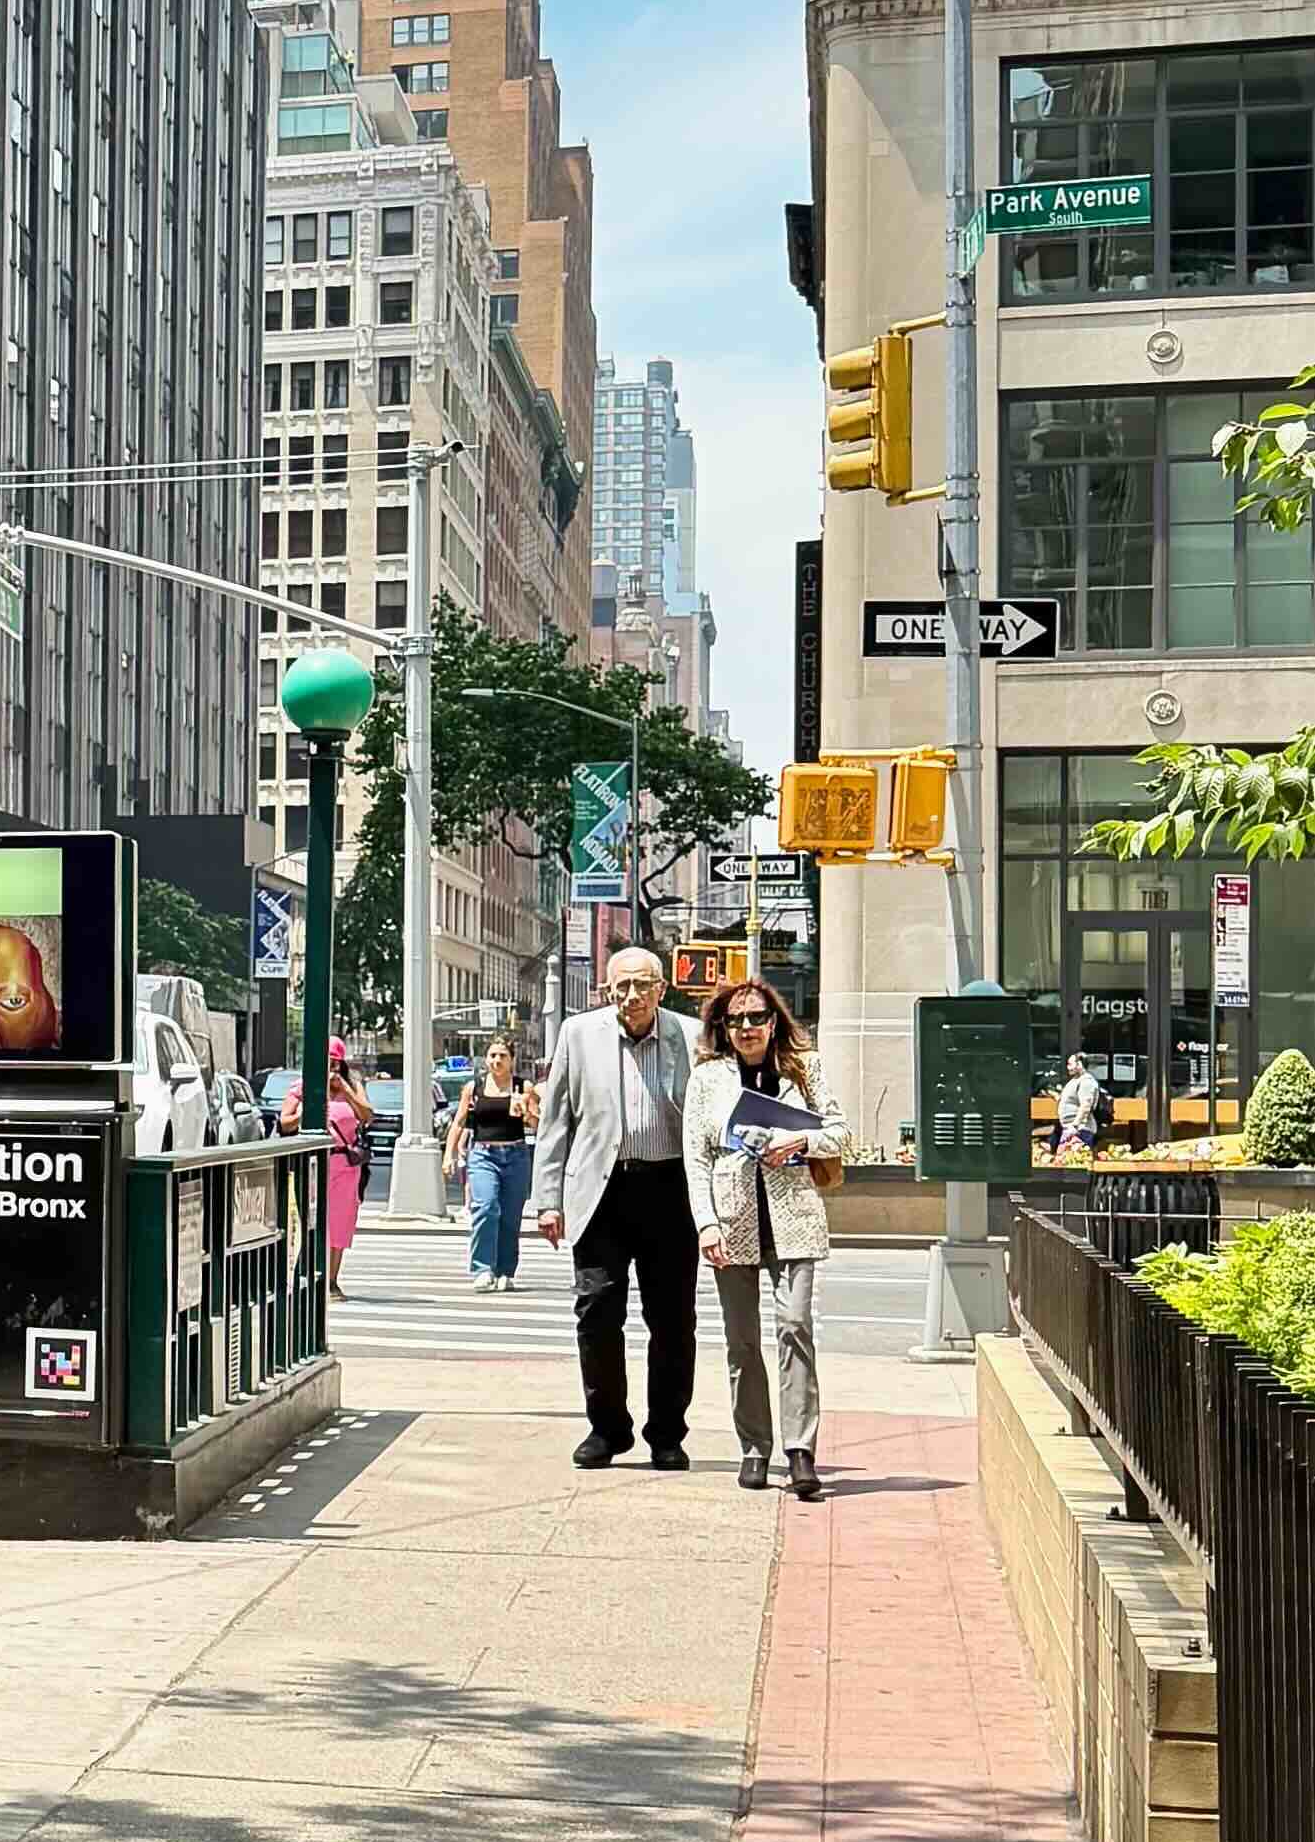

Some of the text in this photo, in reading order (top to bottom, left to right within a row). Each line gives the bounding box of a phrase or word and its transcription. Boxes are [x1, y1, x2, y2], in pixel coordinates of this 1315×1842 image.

[991, 186, 1141, 214] Park Avenue
[1049, 212, 1083, 225] South
[891, 618, 945, 640] ONE
[761, 862, 789, 873] WAY
